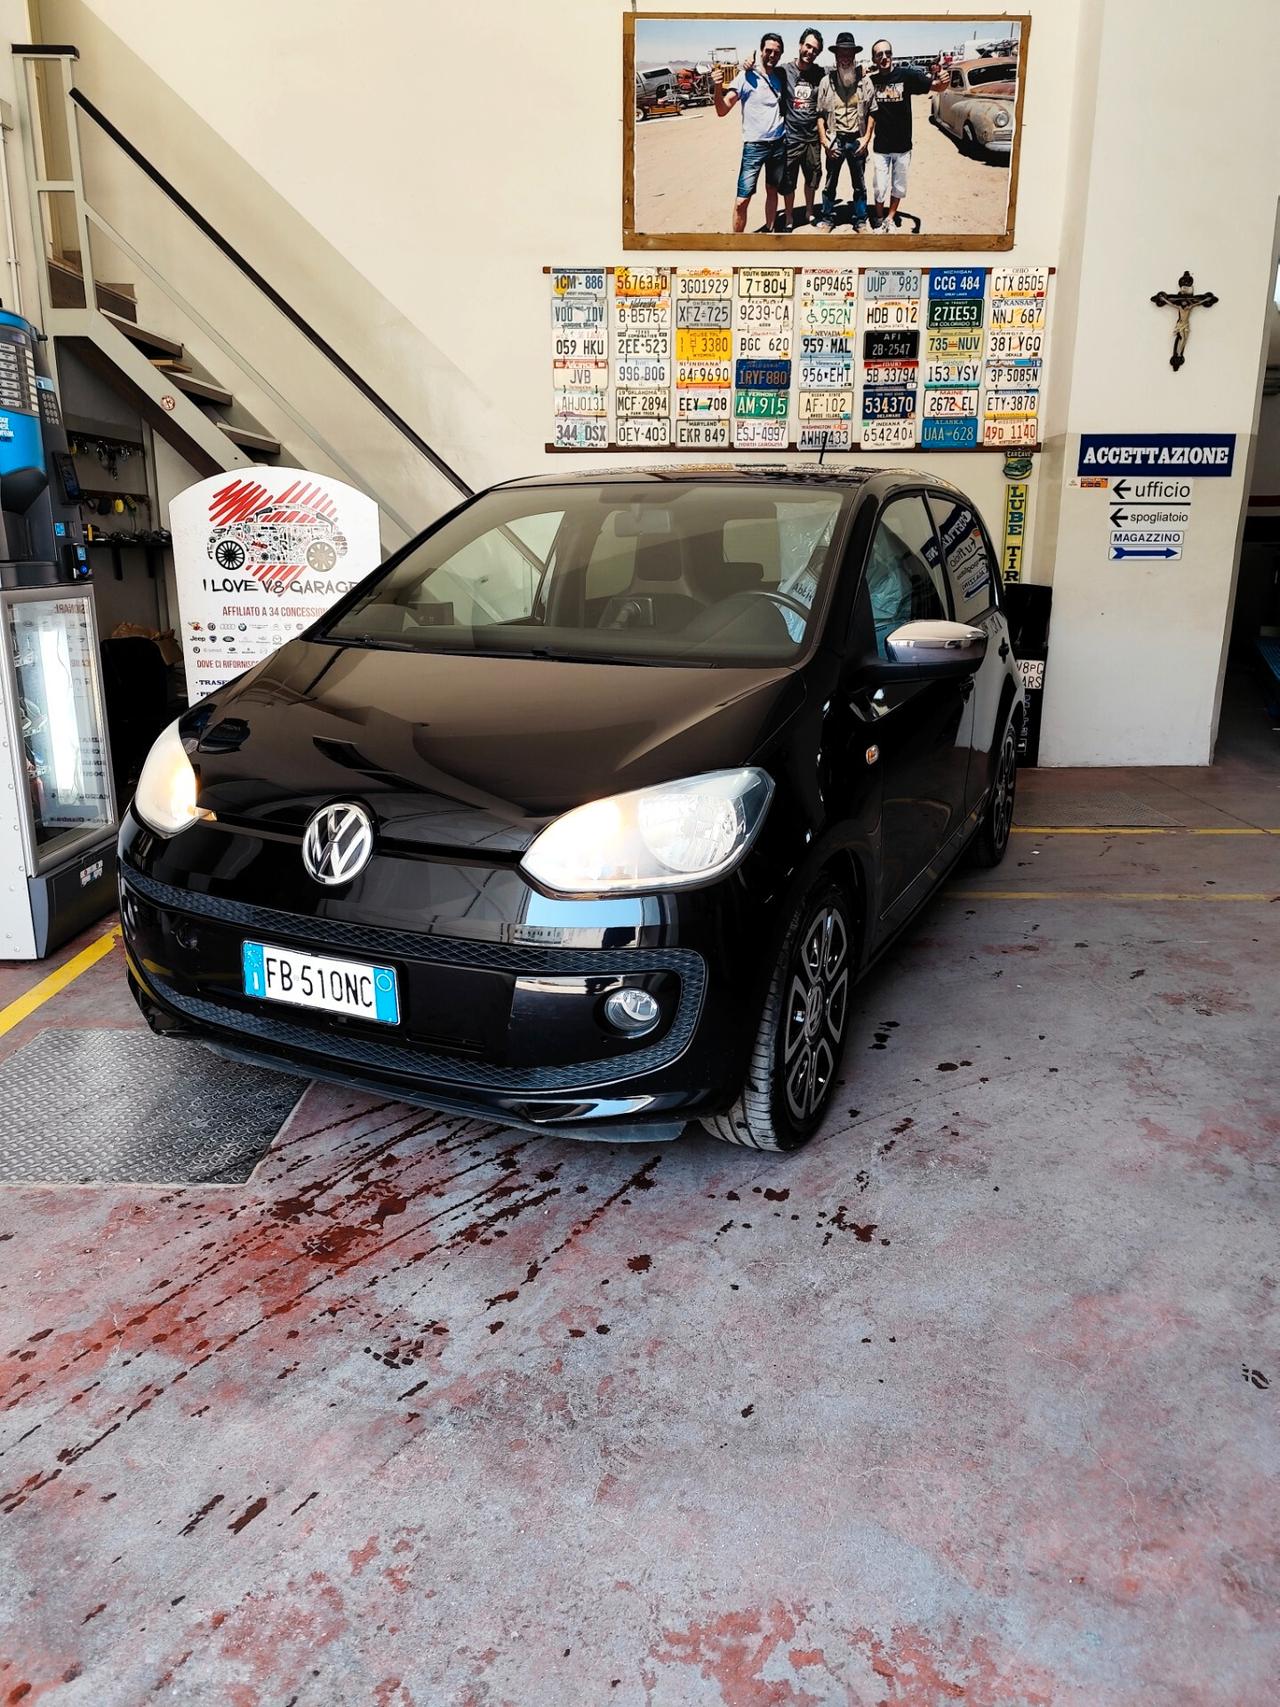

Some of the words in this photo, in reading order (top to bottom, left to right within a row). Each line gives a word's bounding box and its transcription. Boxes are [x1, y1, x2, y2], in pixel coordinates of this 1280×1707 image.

[867, 277, 886, 292] UUP
[899, 276, 918, 292] 983
[934, 276, 956, 290] CCG
[960, 276, 980, 290] 484
[995, 276, 1014, 291] CTX
[1017, 276, 1044, 290] 8505
[867, 308, 888, 323] HDB
[896, 307, 917, 323] 012
[992, 310, 1014, 323] NNJ
[1020, 308, 1042, 323] 687
[584, 340, 603, 354] HKU
[702, 338, 728, 352] 3380
[769, 338, 789, 351] 620
[929, 338, 948, 351] 735
[958, 337, 980, 350] NUV
[991, 337, 1011, 351] 381
[1019, 336, 1041, 351] YGQ
[570, 370, 591, 384] JVB
[884, 368, 915, 382] 33794
[929, 366, 950, 382] 153
[958, 366, 978, 381] YSY
[707, 398, 727, 411] 708
[865, 397, 913, 413] 534370
[930, 397, 955, 411] 2672
[962, 397, 974, 410] EL
[557, 425, 577, 440] 344
[585, 426, 606, 441] DSX
[680, 429, 700, 442] EKR
[705, 429, 725, 442] 849
[925, 427, 944, 441] UAA
[953, 427, 973, 441] 628
[1011, 425, 1035, 439] 1140
[1083, 447, 1229, 464] ACCETTAZIONE
[1136, 481, 1190, 497] ufficio
[1008, 486, 1024, 535] LUBE
[1130, 512, 1188, 524] spogliatoio
[1114, 534, 1180, 542] MAGAZZINO
[1004, 546, 1020, 581] TIR
[203, 579, 206, 591] I
[212, 579, 258, 592] LOVE
[263, 580, 284, 594] V8
[222, 606, 260, 616] AFFILIATO
[262, 607, 268, 616] A
[270, 607, 279, 616] 34
[197, 660, 213, 668] DOVE
[215, 660, 221, 668] CI
[266, 958, 293, 992] FB
[300, 966, 373, 1008] 510NC
